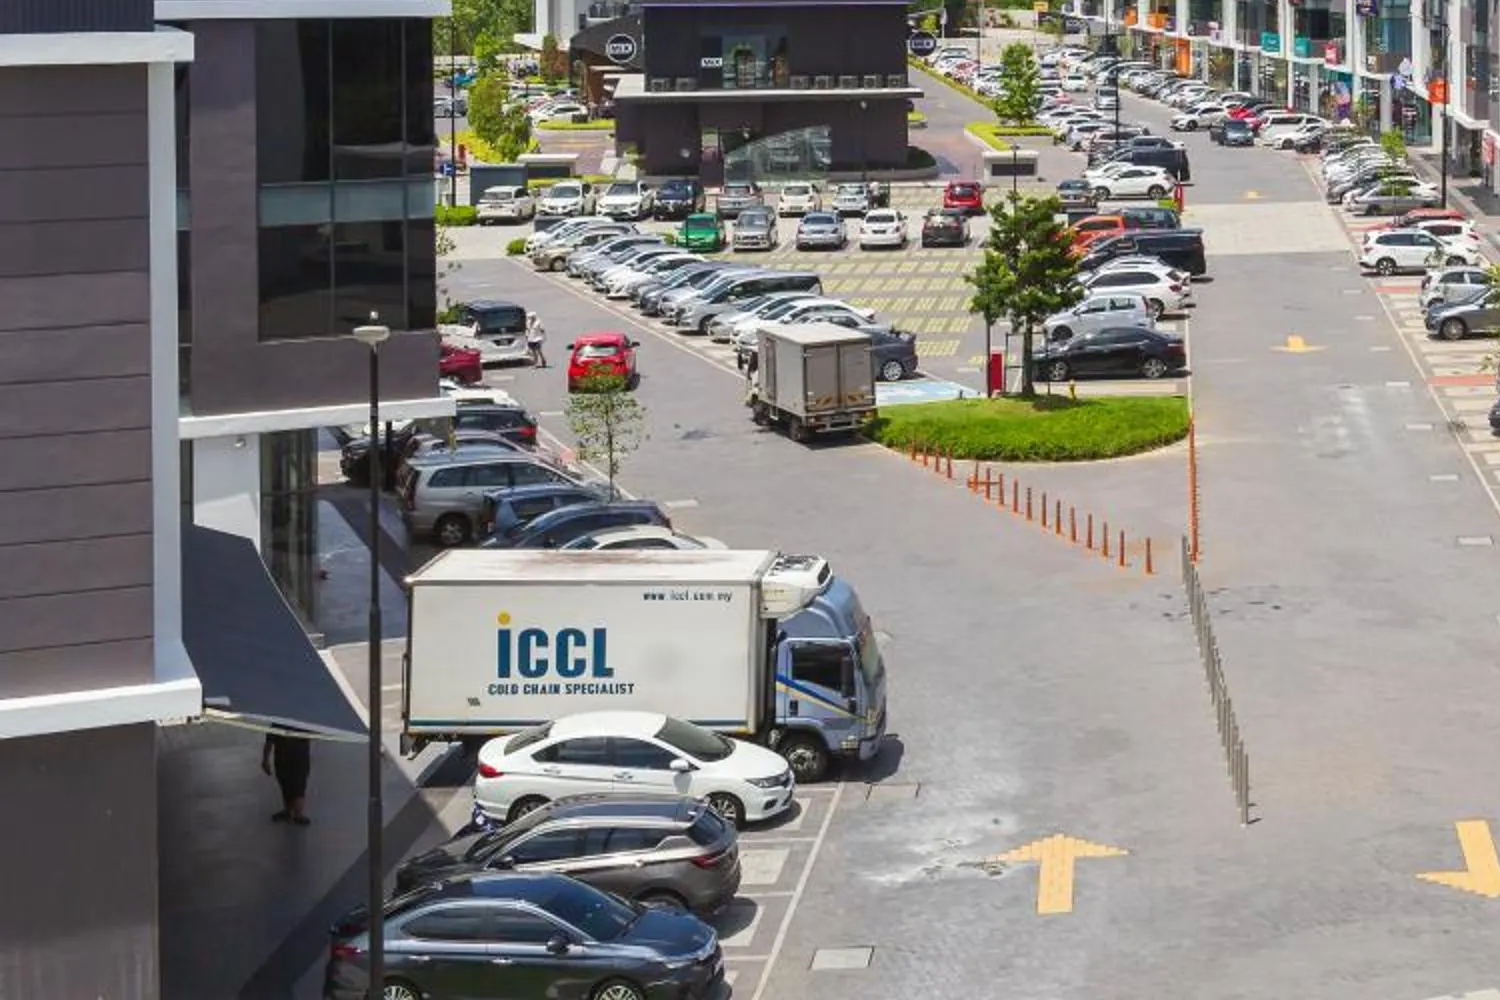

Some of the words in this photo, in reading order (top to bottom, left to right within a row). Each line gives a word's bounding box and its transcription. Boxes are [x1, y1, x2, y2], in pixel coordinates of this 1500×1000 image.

[488, 683, 519, 695] COLD
[524, 683, 560, 695] CHAIN
[565, 683, 635, 695] SPECIALIST
